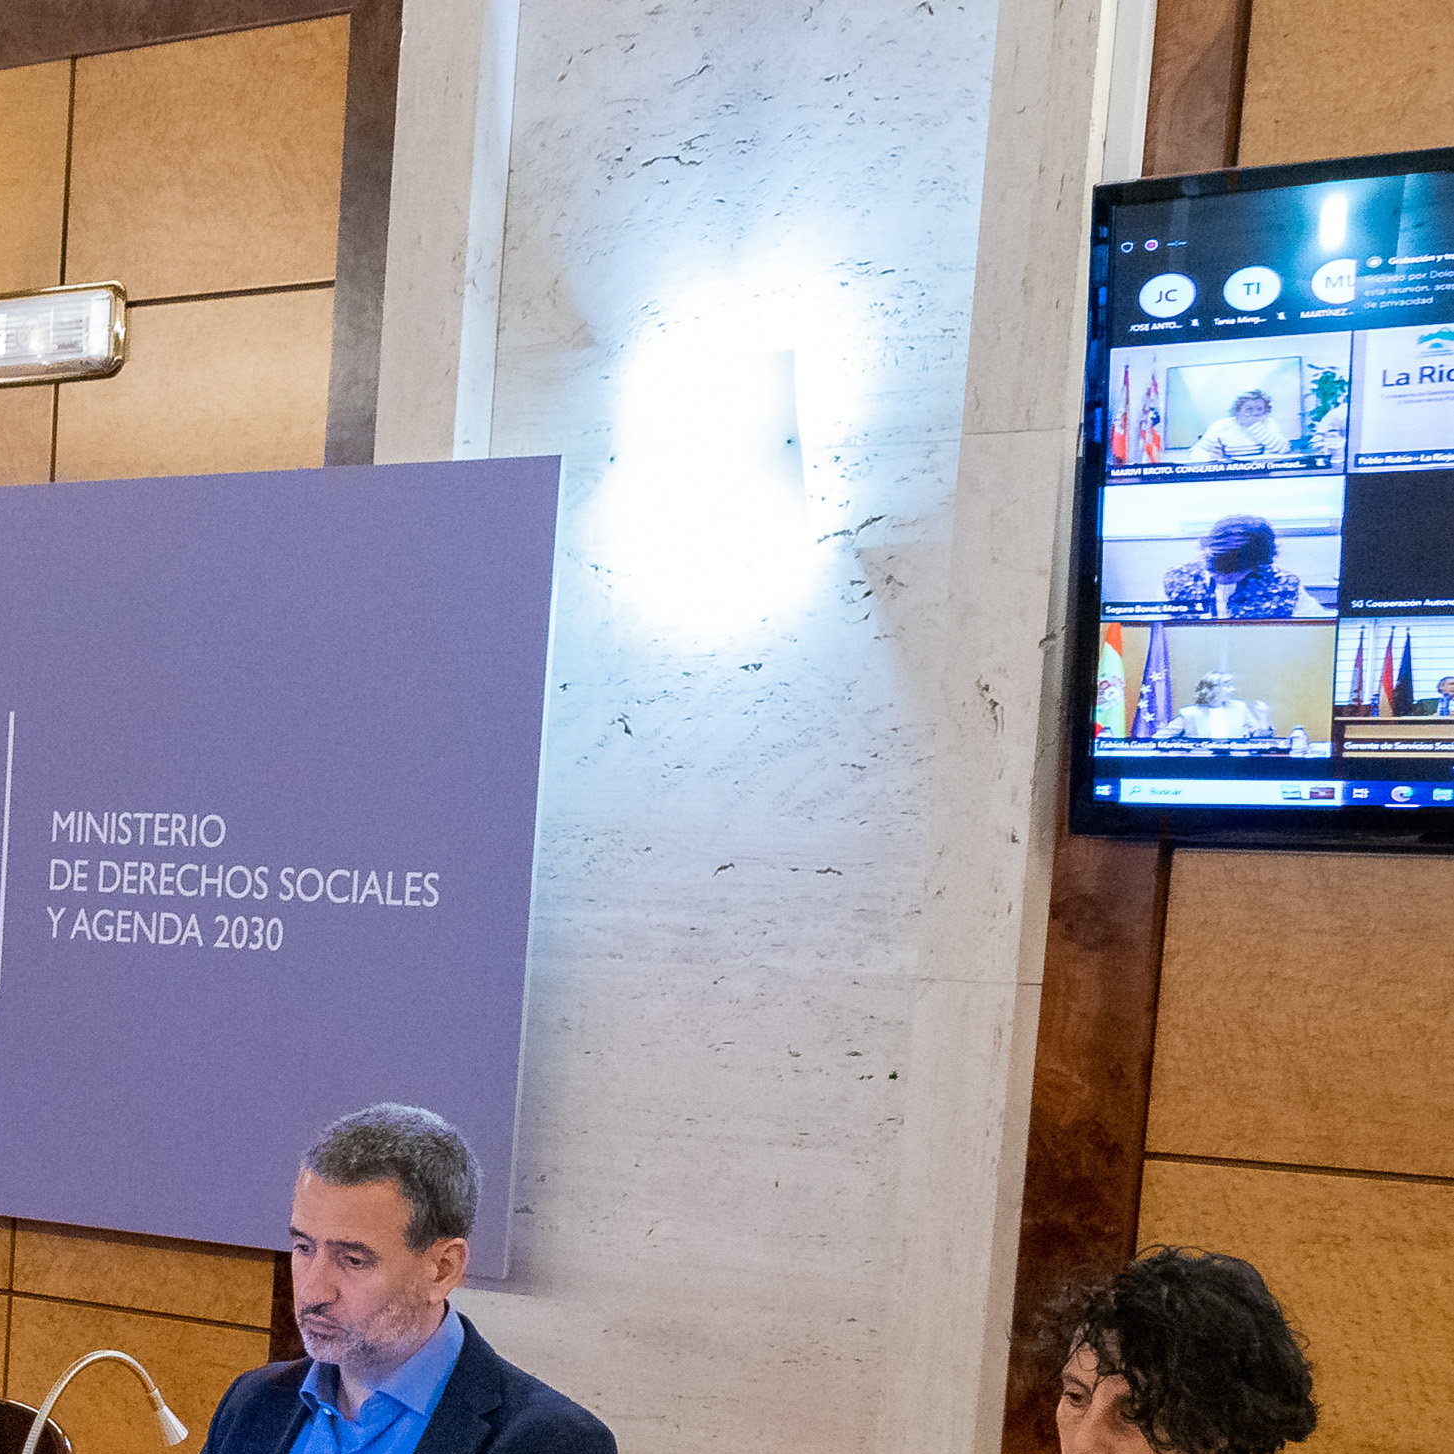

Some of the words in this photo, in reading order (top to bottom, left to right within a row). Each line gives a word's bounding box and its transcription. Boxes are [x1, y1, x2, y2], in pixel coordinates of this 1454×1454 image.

[1408, 272, 1427, 282] por
[1243, 282, 1261, 296] TI
[1364, 288, 1386, 297] esta
[1155, 289, 1178, 304] JC
[1363, 300, 1377, 309] de
[1379, 296, 1434, 308] privacidad
[1382, 369, 1410, 387] La
[1365, 598, 1423, 608] Cooperación
[51, 810, 227, 848] MINISTERIO
[48, 858, 90, 892] DE
[98, 860, 269, 900] DERECHOS
[278, 866, 440, 907] SOCIALES
[46, 906, 66, 939] Y
[69, 907, 204, 947] AGENDA
[213, 914, 284, 951] 2030
